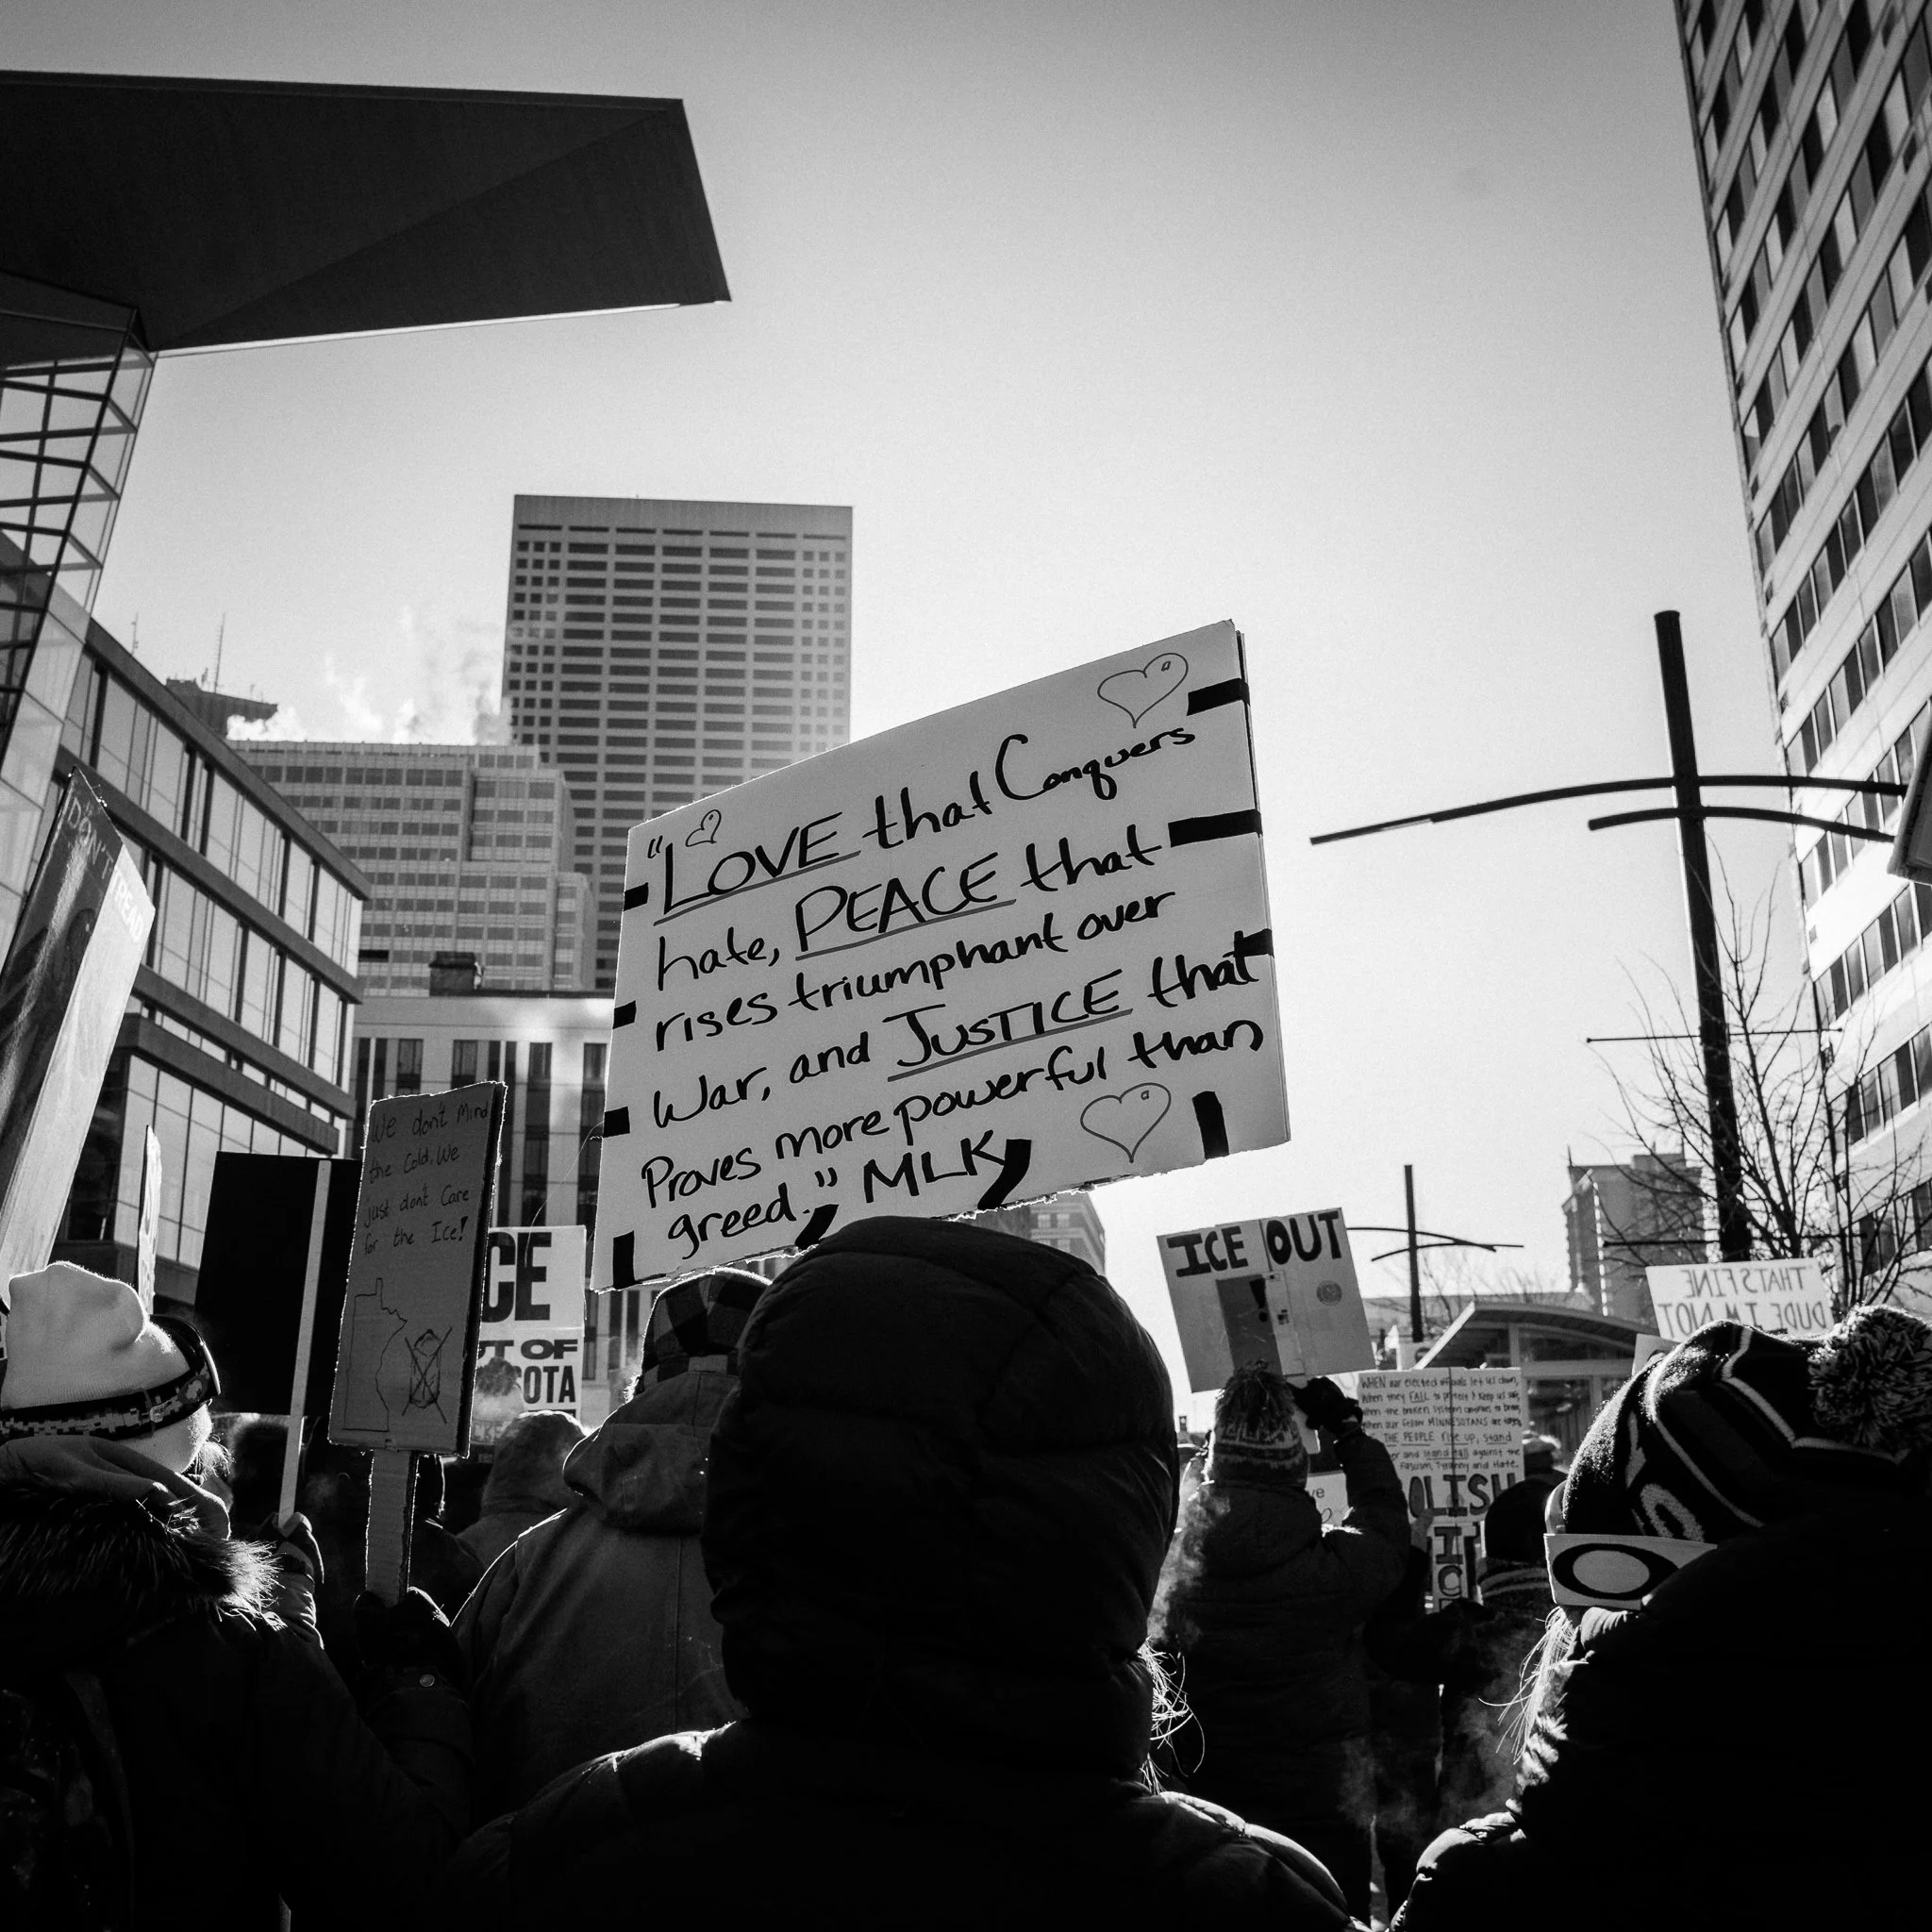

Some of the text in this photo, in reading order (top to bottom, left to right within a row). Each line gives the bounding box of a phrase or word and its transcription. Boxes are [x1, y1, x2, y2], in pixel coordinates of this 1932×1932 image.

[862, 770, 992, 849] that
[995, 727, 1195, 800] Conquers
[658, 824, 1162, 991] hate, PEACE that
[656, 891, 1175, 1052] rises triumphant over
[653, 930, 1259, 1128] War, and JUSTICE that
[370, 1111, 397, 1143] We
[641, 1019, 1264, 1208] Proves more powerful than
[369, 1158, 391, 1184] the
[437, 1144, 459, 1166] We
[863, 1129, 1005, 1203] MLK
[364, 1198, 390, 1228] just
[441, 1184, 469, 1207] Care
[364, 1216, 468, 1256] for the Ice!
[1166, 1210, 1341, 1277] ICE OUT
[481, 1232, 552, 1323] CE
[521, 1340, 577, 1359] OF
[1360, 1375, 1387, 1389] WHEN
[1470, 1376, 1483, 1387] let
[1486, 1375, 1495, 1385] us
[1409, 1391, 1429, 1402] FAIL
[1384, 1432, 1398, 1442] THE
[1404, 1431, 1434, 1441] PEOPLE
[1473, 1460, 1490, 1469] and
